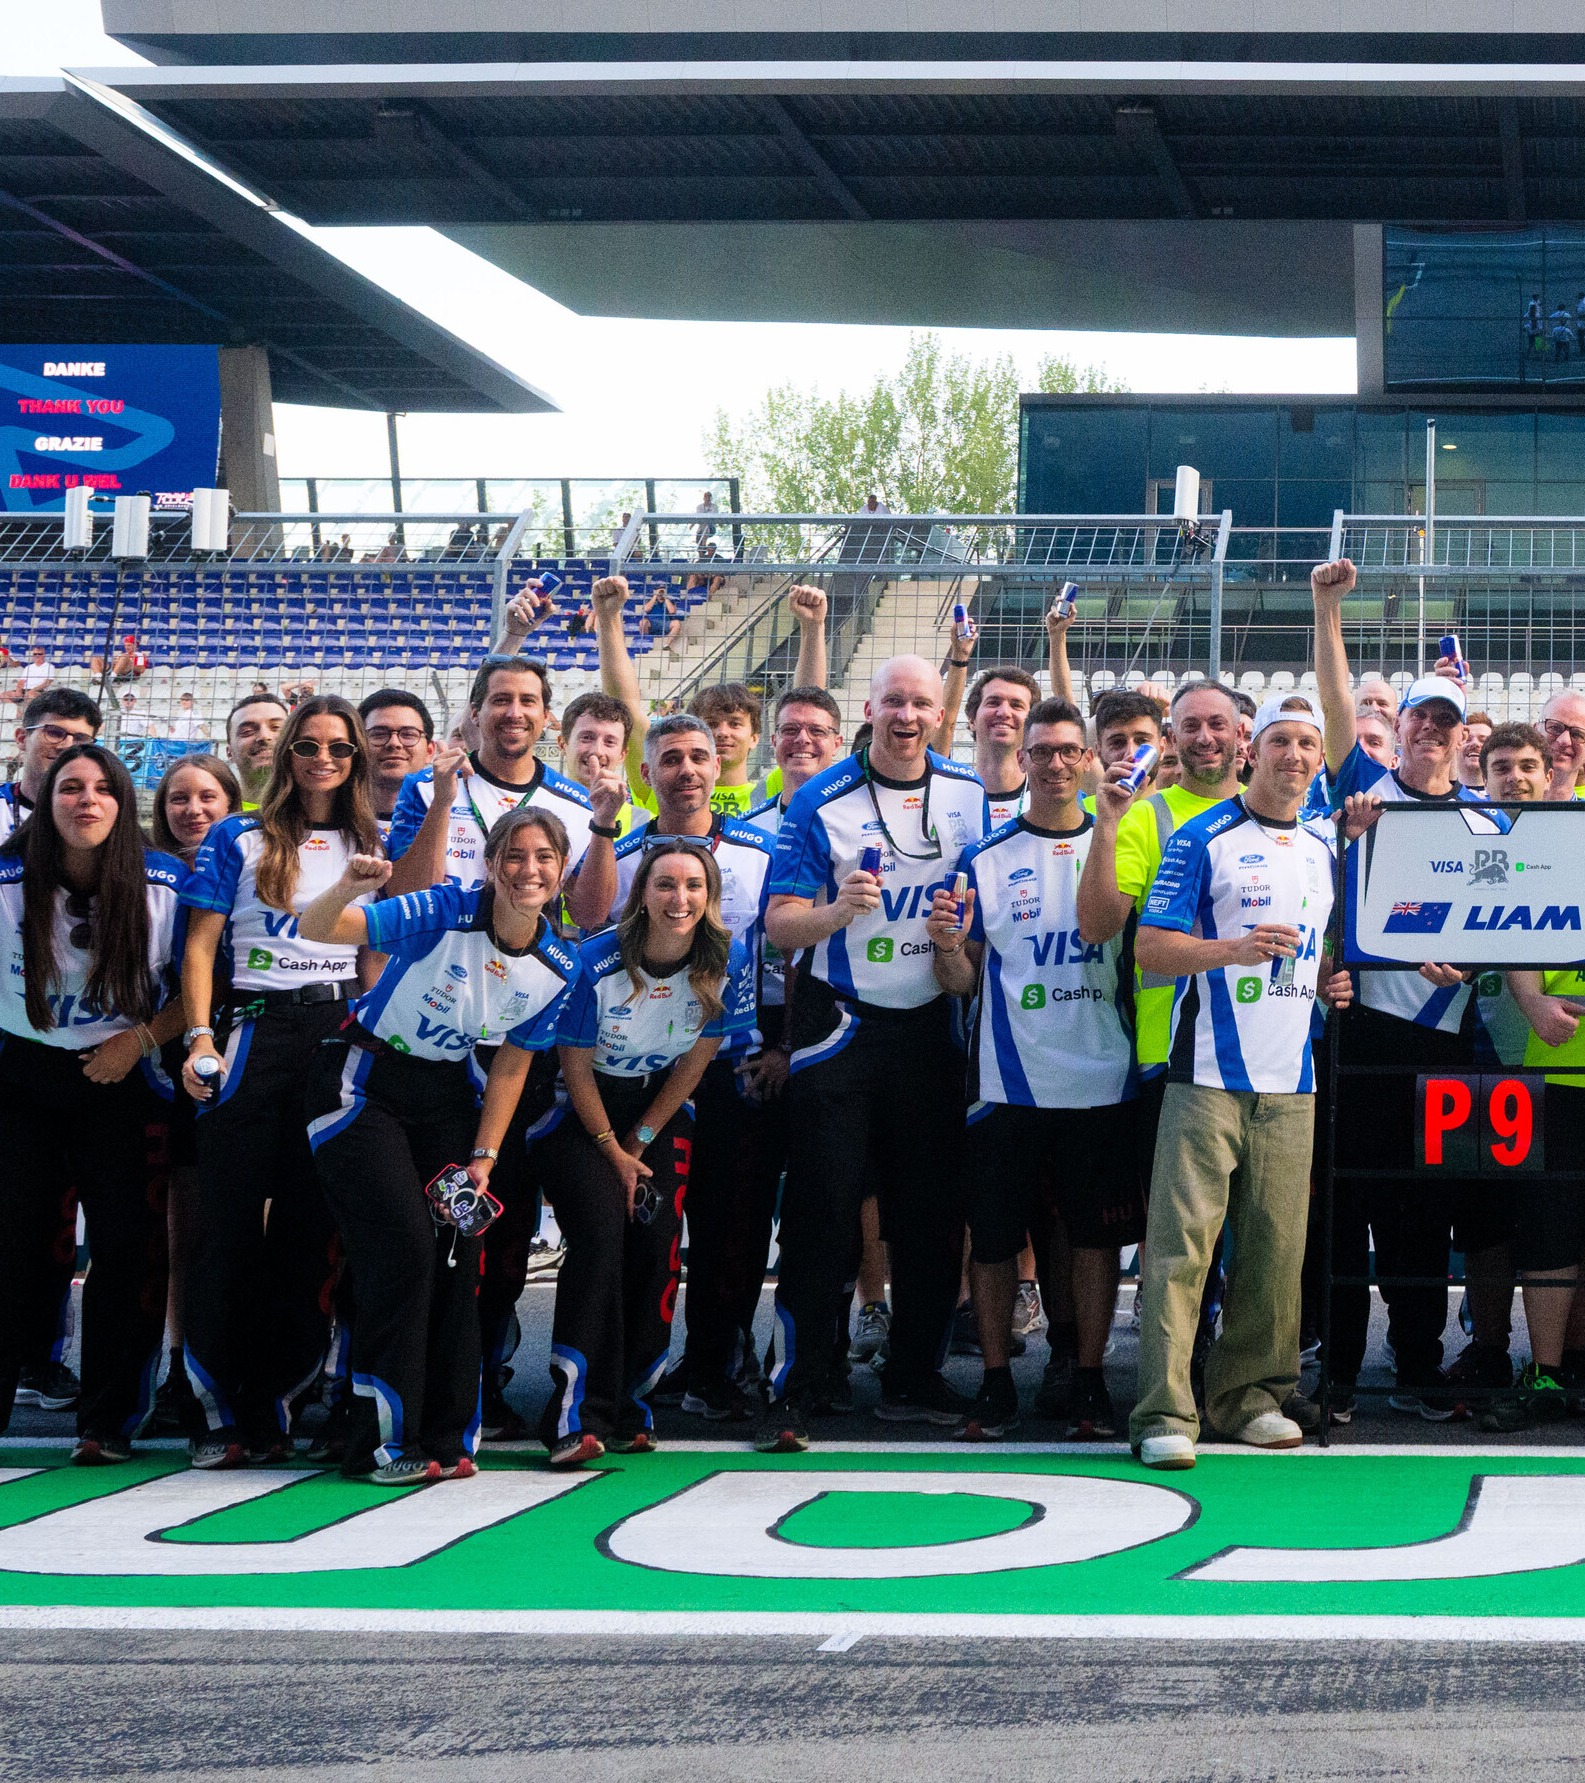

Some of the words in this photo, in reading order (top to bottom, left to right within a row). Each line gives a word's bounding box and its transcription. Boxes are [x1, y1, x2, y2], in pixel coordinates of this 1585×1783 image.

[44, 363, 105, 376] DANKE
[18, 400, 81, 413] THANK
[86, 400, 124, 413] YOU
[35, 437, 103, 451] GRAZIE
[9, 474, 60, 488] DANK
[65, 474, 78, 488] U
[83, 474, 122, 488] WEL
[942, 763, 975, 778] HUGO
[554, 781, 589, 803] HUGO
[820, 774, 852, 797] HUGO
[737, 802, 767, 820] HUGO
[1205, 813, 1233, 834] HUGO
[729, 829, 764, 844] HUGO
[976, 827, 1007, 849] HUGO
[1176, 839, 1191, 848] VISA
[614, 836, 641, 855] UGO
[0, 866, 25, 880] HUG
[878, 862, 896, 872] obil
[1428, 860, 1464, 873] VISA
[1540, 863, 1551, 871] App
[1241, 884, 1271, 893] TUDOR
[881, 881, 947, 922] VIS
[1010, 896, 1040, 908] TUDOR
[1241, 896, 1271, 908] Mobil
[458, 914, 473, 924] HU
[1012, 907, 1041, 923] Mobil
[1463, 905, 1582, 931] LIAM
[257, 911, 299, 939] VI
[900, 940, 936, 956] Cash
[1023, 928, 1105, 967] VISA
[278, 957, 318, 971] Cash
[320, 958, 348, 973] App
[546, 944, 574, 971] HUGO
[593, 951, 621, 973] HUGO
[761, 961, 785, 975] Cas
[431, 986, 457, 1004] TUDOR
[515, 991, 529, 999] VISA
[1052, 986, 1090, 1002] Cash
[1267, 983, 1297, 998] Cash
[422, 993, 451, 1014] Mobil
[600, 1030, 629, 1041] TUDOR
[598, 1036, 626, 1052] Mobil
[605, 1054, 669, 1072] VIS
[1424, 1079, 1533, 1167] P9
